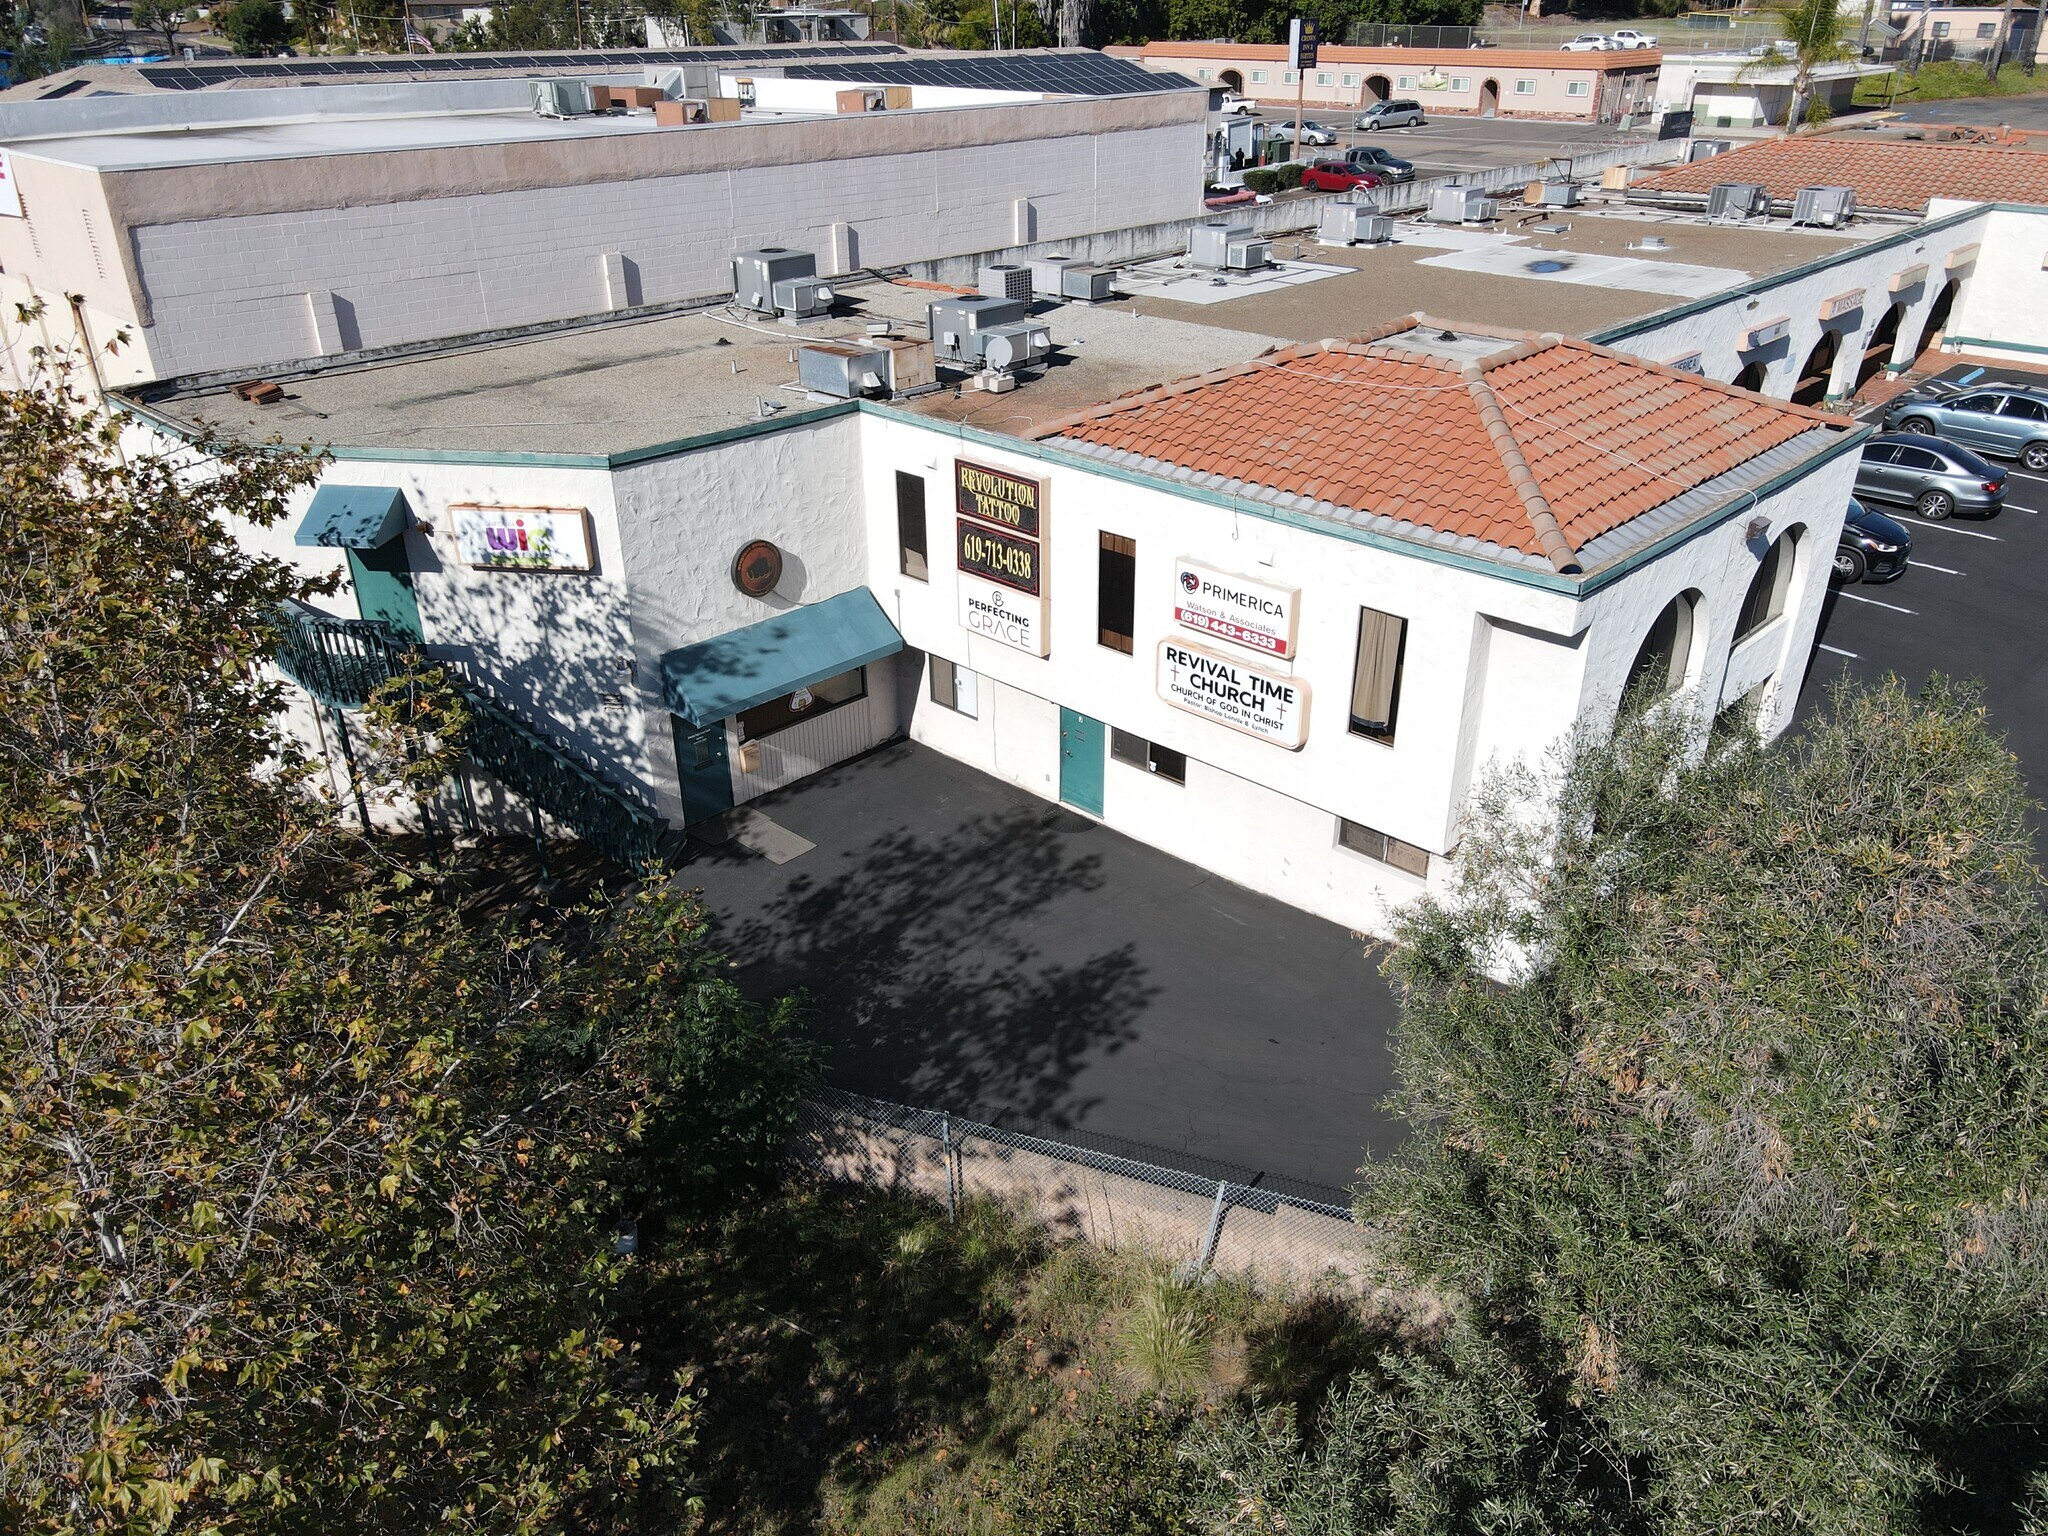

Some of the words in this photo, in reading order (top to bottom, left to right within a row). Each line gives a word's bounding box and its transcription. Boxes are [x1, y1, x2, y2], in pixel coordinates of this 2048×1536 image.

[1837, 290, 1866, 313] MASSAGE
[961, 466, 1036, 510] REVOLUTION
[975, 493, 1020, 526] TATTOO
[964, 533, 1031, 579] 619-713-0338
[968, 597, 1030, 627] PERFECTING
[1186, 600, 1217, 617] Watson
[1219, 611, 1226, 619] &
[1229, 614, 1277, 636] Associates
[1202, 581, 1284, 619] PRIMERICA
[968, 610, 1030, 648] GRACE
[1181, 609, 1209, 629] (619)
[1210, 620, 1276, 649] 443-6333
[1166, 646, 1241, 686] REVIVAL
[1249, 674, 1294, 704] TIME
[1189, 673, 1265, 712] CHURCH
[1171, 683, 1204, 702] CHURCH
[1206, 696, 1217, 706] OF
[1219, 701, 1239, 714] GOD
[1241, 709, 1251, 719] IN
[1253, 713, 1284, 731] CHRIST
[1204, 705, 1222, 717] Bishop
[1224, 712, 1243, 725] Lonnie
[1251, 722, 1269, 734] Lynch
